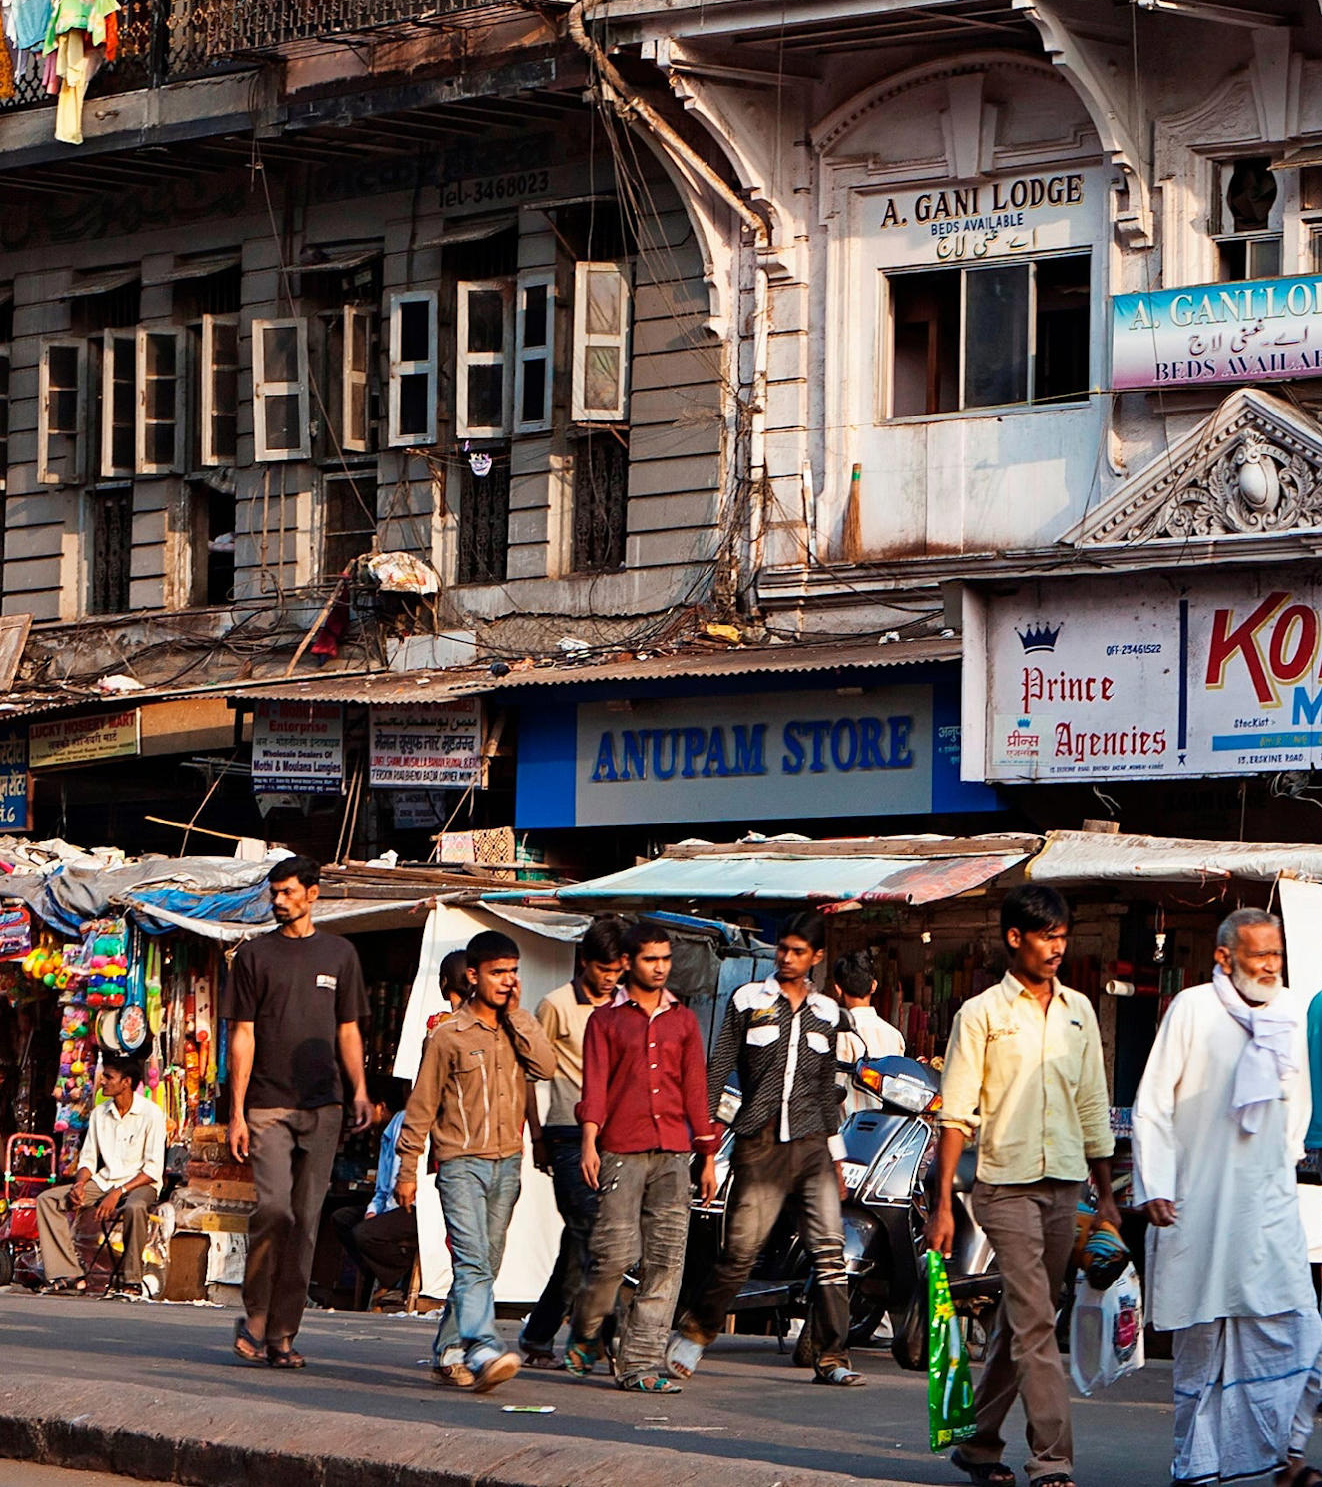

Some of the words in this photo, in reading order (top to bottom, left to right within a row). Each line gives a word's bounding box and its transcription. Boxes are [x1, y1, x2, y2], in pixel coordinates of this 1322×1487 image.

[880, 198, 908, 229] A.
[914, 186, 980, 224] GANI
[991, 174, 1085, 213] LODGE
[931, 221, 960, 236] BEDS
[963, 213, 1024, 233] AVAILABLE
[1129, 299, 1161, 331] A.
[1169, 288, 1258, 328] GANI
[1153, 358, 1216, 382] BEDS
[1021, 667, 1116, 714] Prince
[269, 720, 328, 735] Enterprise
[1054, 721, 1167, 763] Agencies
[591, 722, 769, 783] ANUPAM
[781, 715, 915, 776] STORE
